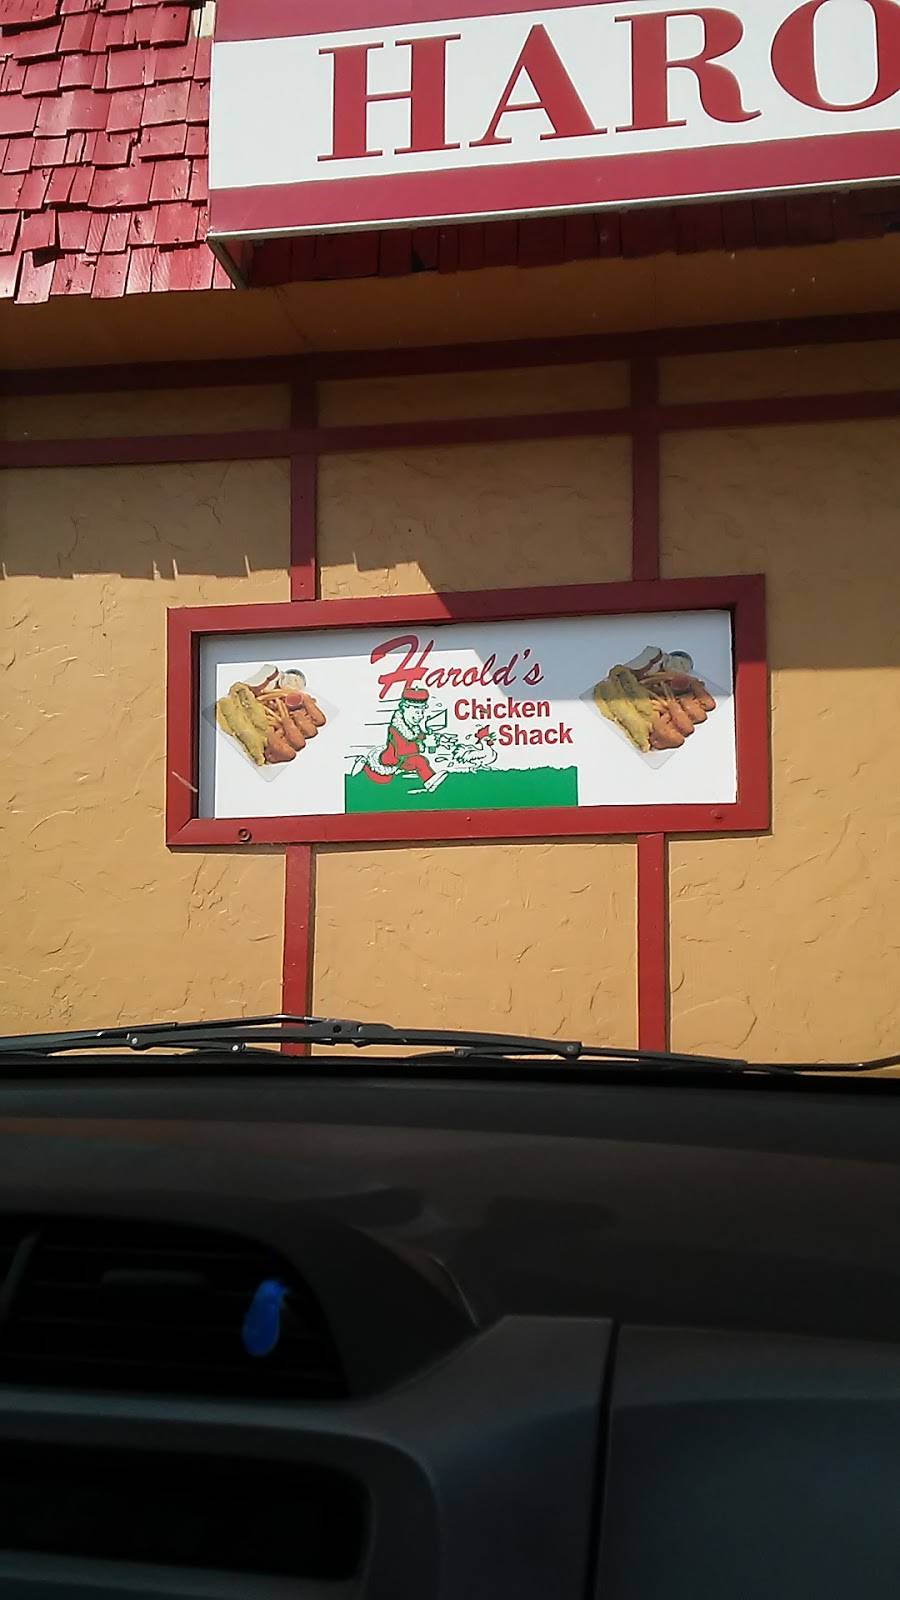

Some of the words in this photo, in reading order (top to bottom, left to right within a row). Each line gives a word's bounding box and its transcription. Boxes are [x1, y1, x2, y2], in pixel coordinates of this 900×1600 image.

[370, 634, 544, 699] Harold's
[454, 697, 550, 720] Chicken
[498, 722, 573, 746] Shack
